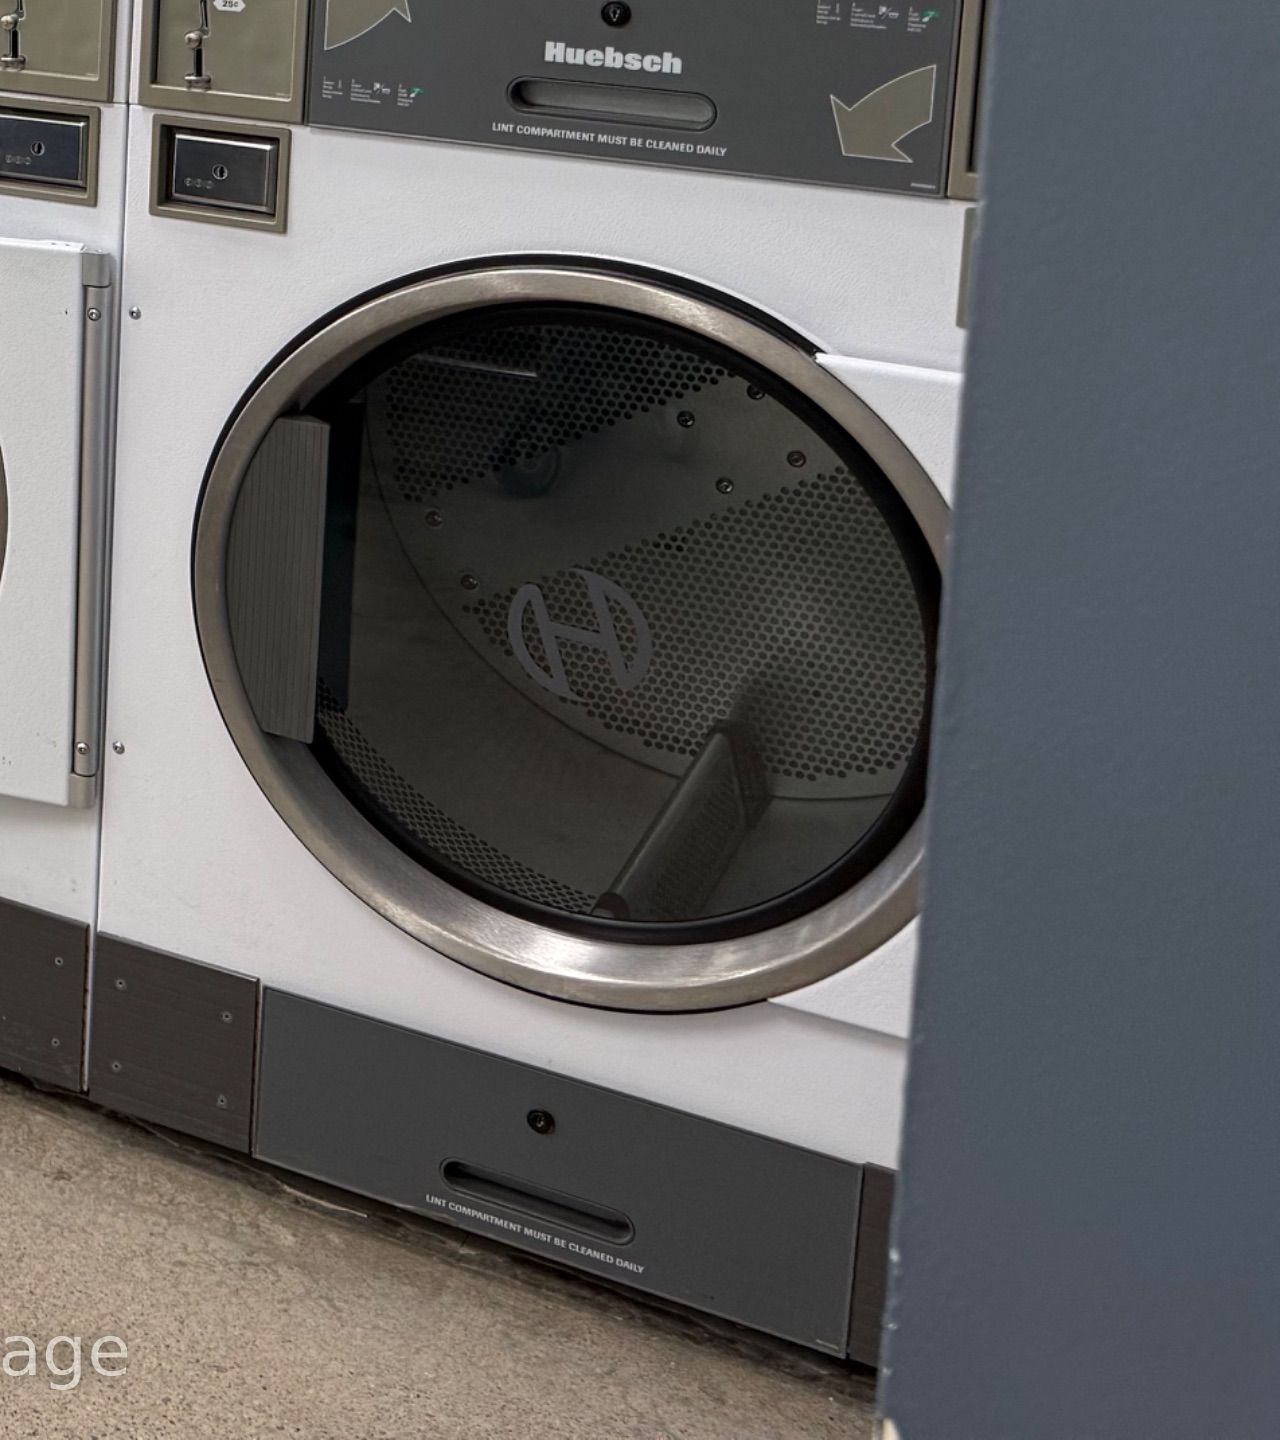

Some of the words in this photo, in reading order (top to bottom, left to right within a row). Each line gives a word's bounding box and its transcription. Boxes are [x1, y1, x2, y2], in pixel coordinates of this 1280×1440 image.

[544, 40, 683, 74] Huebsch
[492, 122, 515, 134] LINT
[516, 124, 595, 142] COMPARTMENT
[597, 133, 628, 146] MUST
[630, 137, 644, 148] BE
[646, 138, 694, 154] CLEANED
[696, 143, 727, 157] DAILY
[425, 1193, 447, 1210] LINT
[448, 1201, 522, 1233] COMPARTMENT
[523, 1226, 552, 1244] MUST
[553, 1236, 567, 1249] BE
[568, 1242, 614, 1264] CLEANED
[615, 1256, 645, 1275] DAILY
